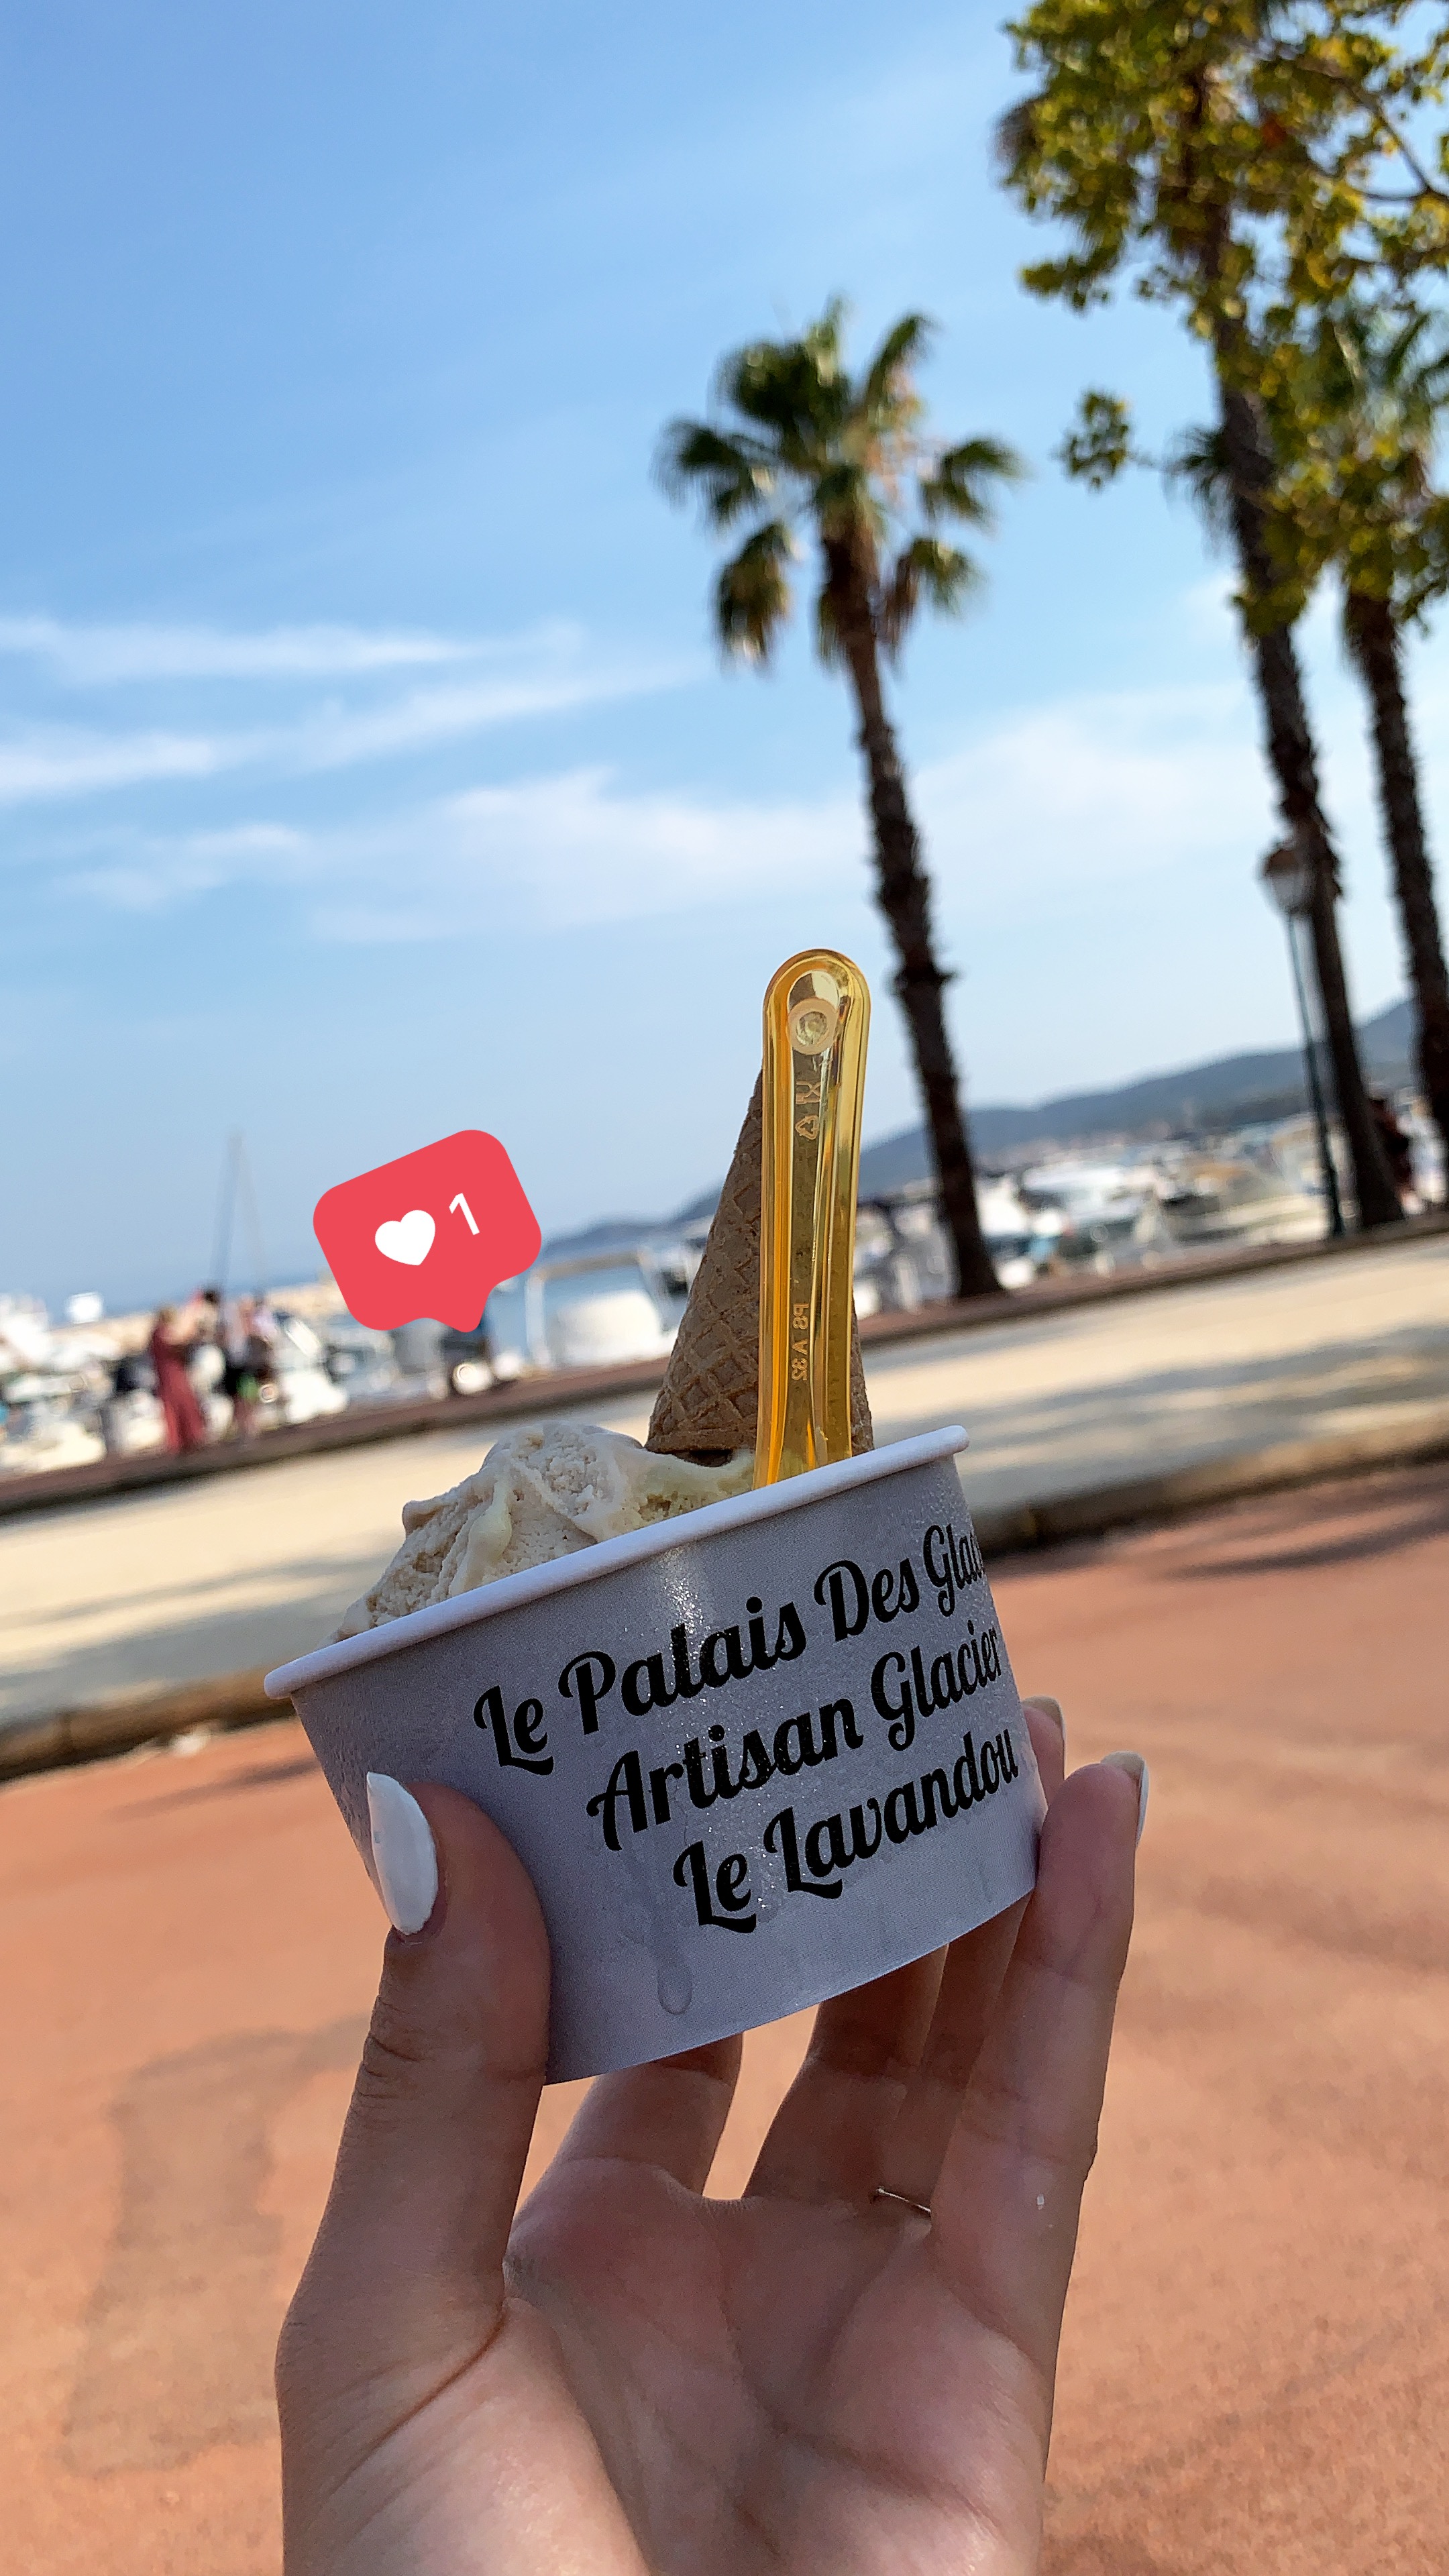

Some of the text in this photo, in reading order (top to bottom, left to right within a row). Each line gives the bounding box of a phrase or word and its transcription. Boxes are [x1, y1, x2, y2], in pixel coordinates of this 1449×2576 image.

[473, 1523, 985, 1776] Le Palais Des Glac
[586, 1619, 1002, 1852] Artisan Glacier
[672, 1728, 1020, 1934] Le Lavandou
